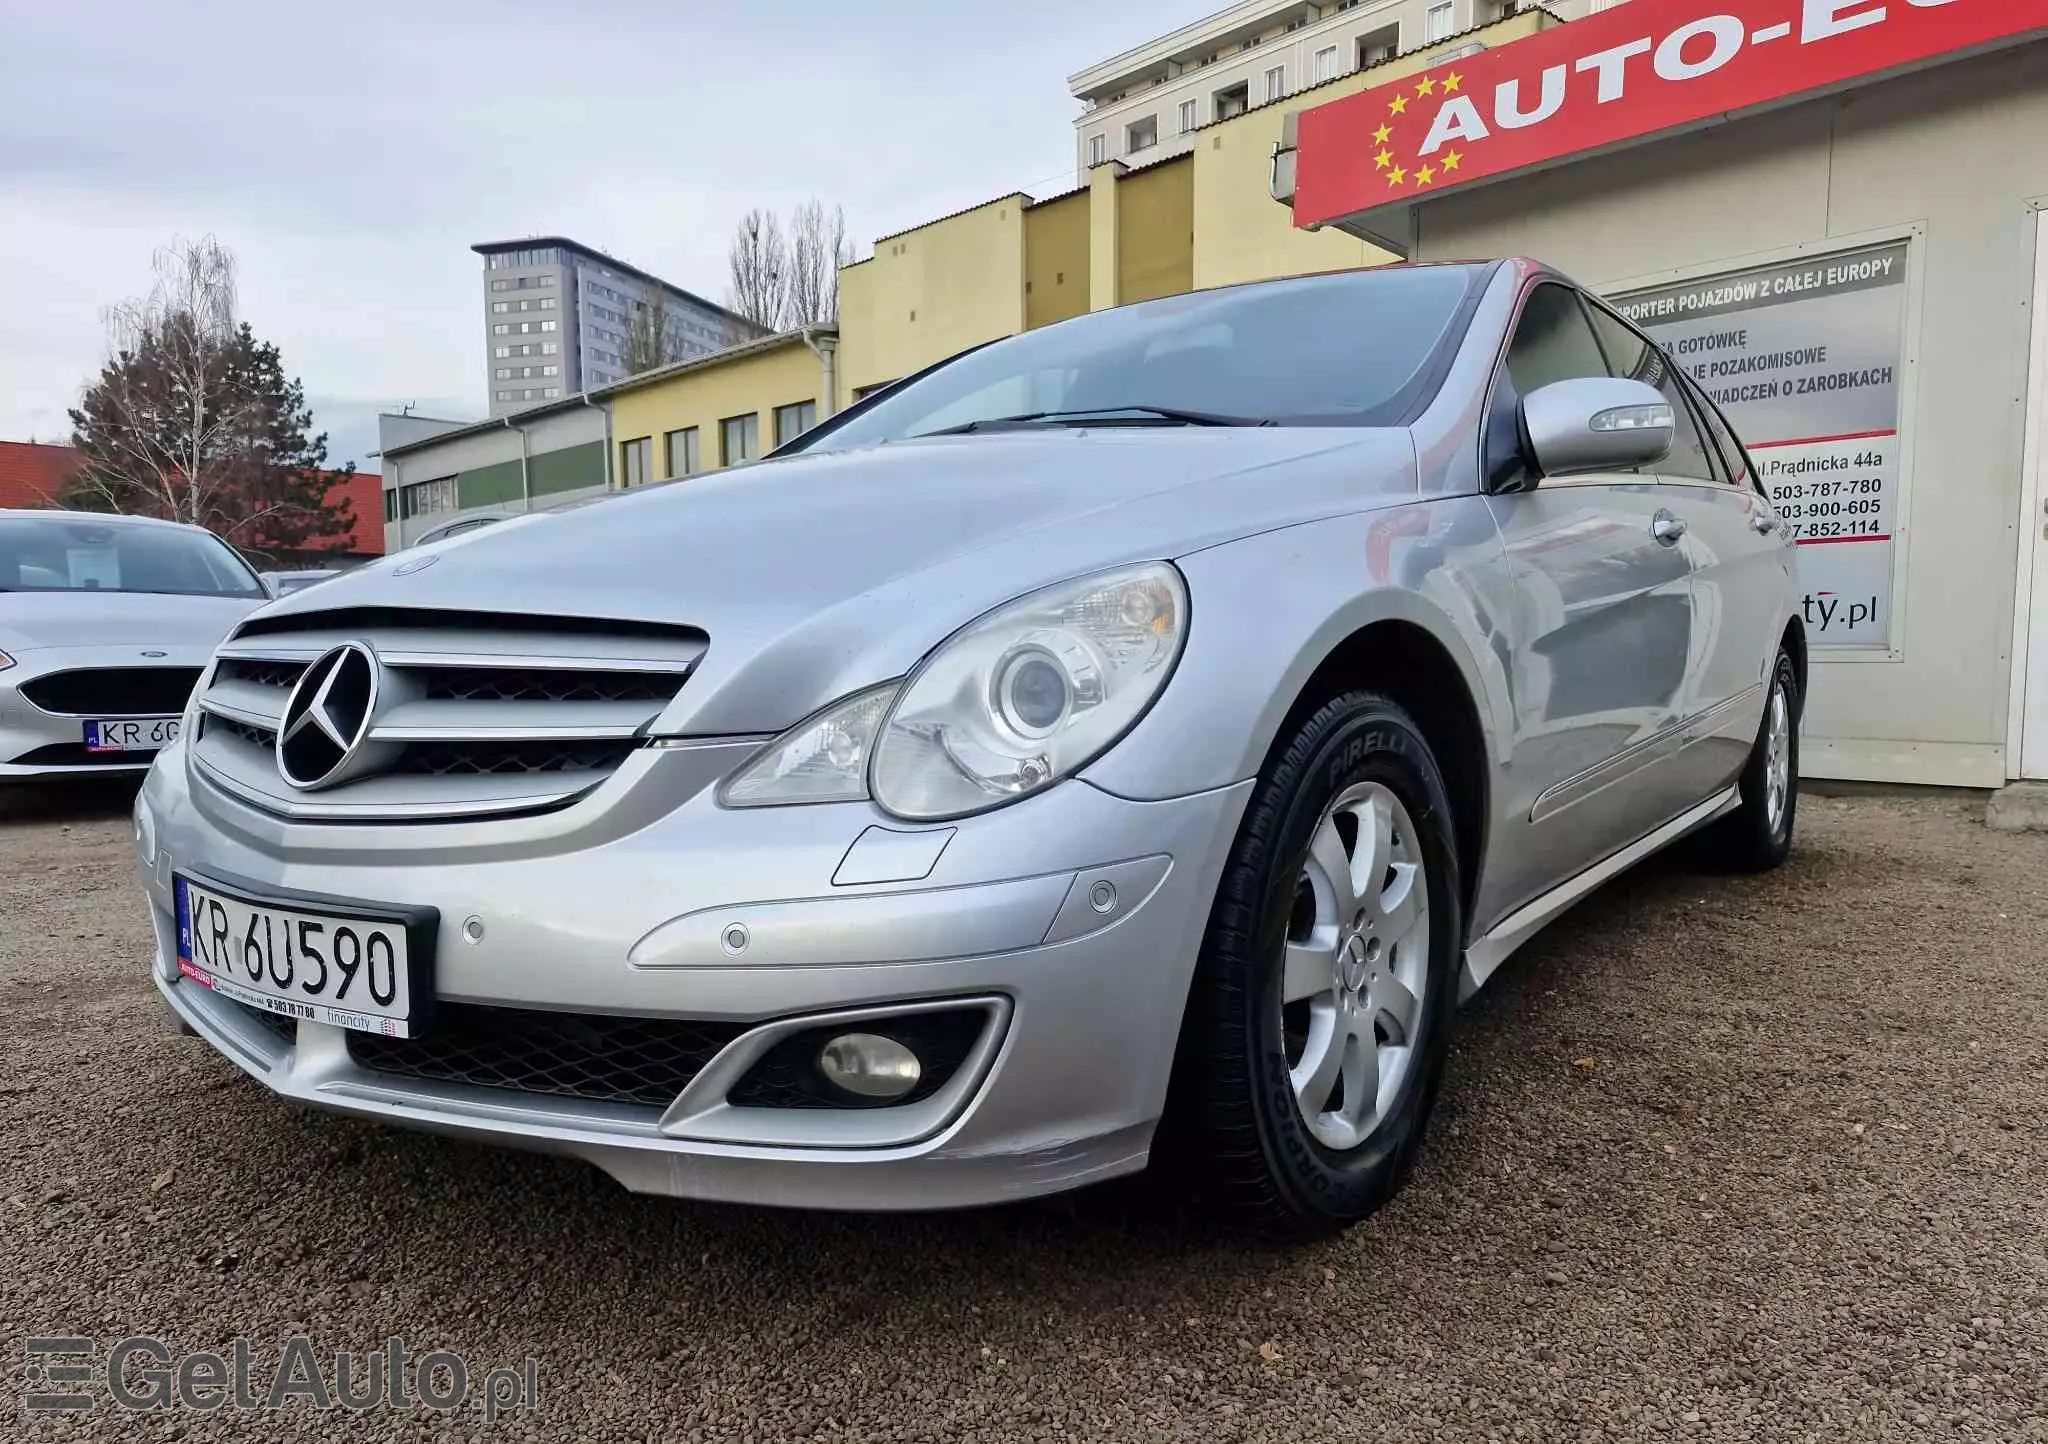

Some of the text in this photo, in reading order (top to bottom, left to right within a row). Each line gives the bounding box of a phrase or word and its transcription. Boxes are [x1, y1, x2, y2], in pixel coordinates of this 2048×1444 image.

[1417, 0, 1957, 157] AUTO-E
[1619, 257, 1894, 322] PORTER POJAZDÓW Z CAŁEJ EUROPY
[1678, 329, 1748, 355] GOTÓWKĘ
[1710, 346, 1828, 378] POZAKOMISOWE
[1782, 384, 1792, 396] O
[1796, 366, 1893, 395] ZAROBKACH
[1853, 451, 1882, 468] 44a
[1773, 478, 1882, 501] 503-787-780
[1792, 519, 1880, 537] 7-852-114
[1802, 594, 1877, 631] ty.pl
[103, 722, 140, 744] KR
[1330, 730, 1407, 788] PIRELLI
[182, 930, 191, 947] PL
[190, 890, 396, 1007] KR 6U590
[327, 1008, 371, 1031] financity
[1267, 1050, 1358, 1206] CORPION
